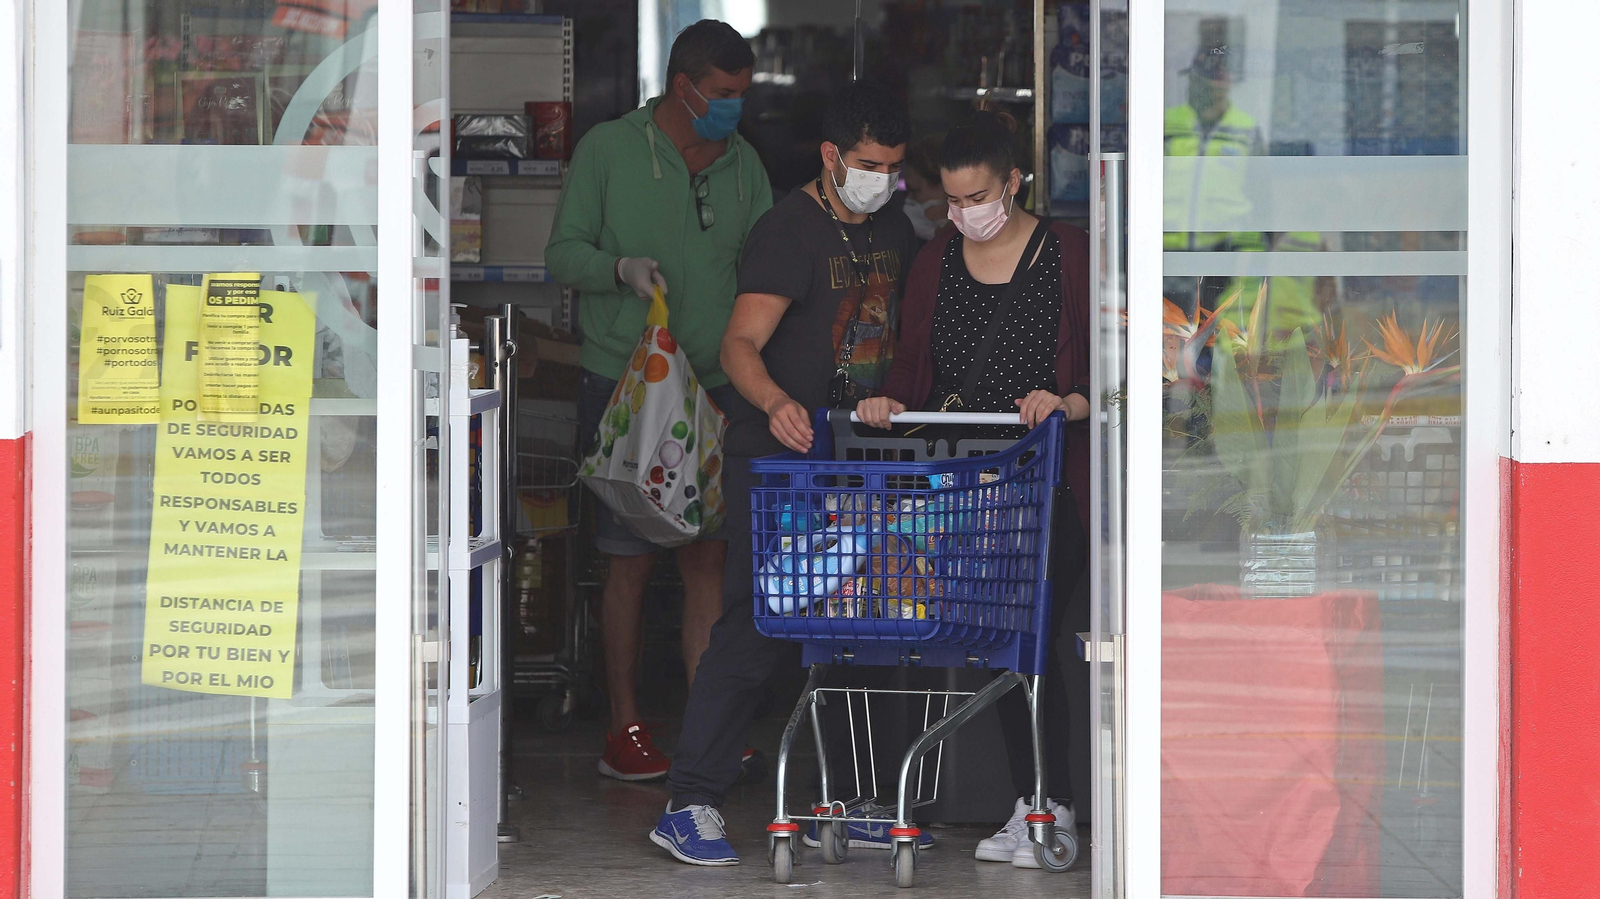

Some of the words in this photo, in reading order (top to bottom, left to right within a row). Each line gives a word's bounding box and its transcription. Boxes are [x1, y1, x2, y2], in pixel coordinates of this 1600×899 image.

[209, 296, 223, 304] OS
[225, 297, 259, 305] PEDIM
[102, 306, 125, 316] Ruiz
[127, 306, 154, 316] Galá
[167, 422, 191, 436] DE
[196, 422, 298, 439] SEGURIDAD
[75, 436, 99, 452] BPA
[74, 452, 99, 465] FREE
[172, 446, 236, 461] VAMOS
[241, 450, 253, 461] A
[259, 450, 291, 463] SER
[200, 471, 261, 485] TODOS
[160, 495, 297, 514] RESPONSABLES
[179, 520, 190, 532] Y
[195, 521, 259, 536] VAMOS
[263, 525, 276, 537] A
[164, 542, 260, 560] MANTENER
[266, 548, 288, 561] LA
[160, 596, 255, 612] DISTANCIA
[260, 601, 284, 613] DE
[169, 620, 272, 636] SEGURIDAD
[149, 643, 190, 658] POR
[196, 646, 220, 659] TU
[227, 648, 271, 662] BIEN
[278, 650, 290, 663] Y
[162, 671, 202, 686] POR
[209, 673, 230, 686] EL
[237, 675, 274, 689] MIO
